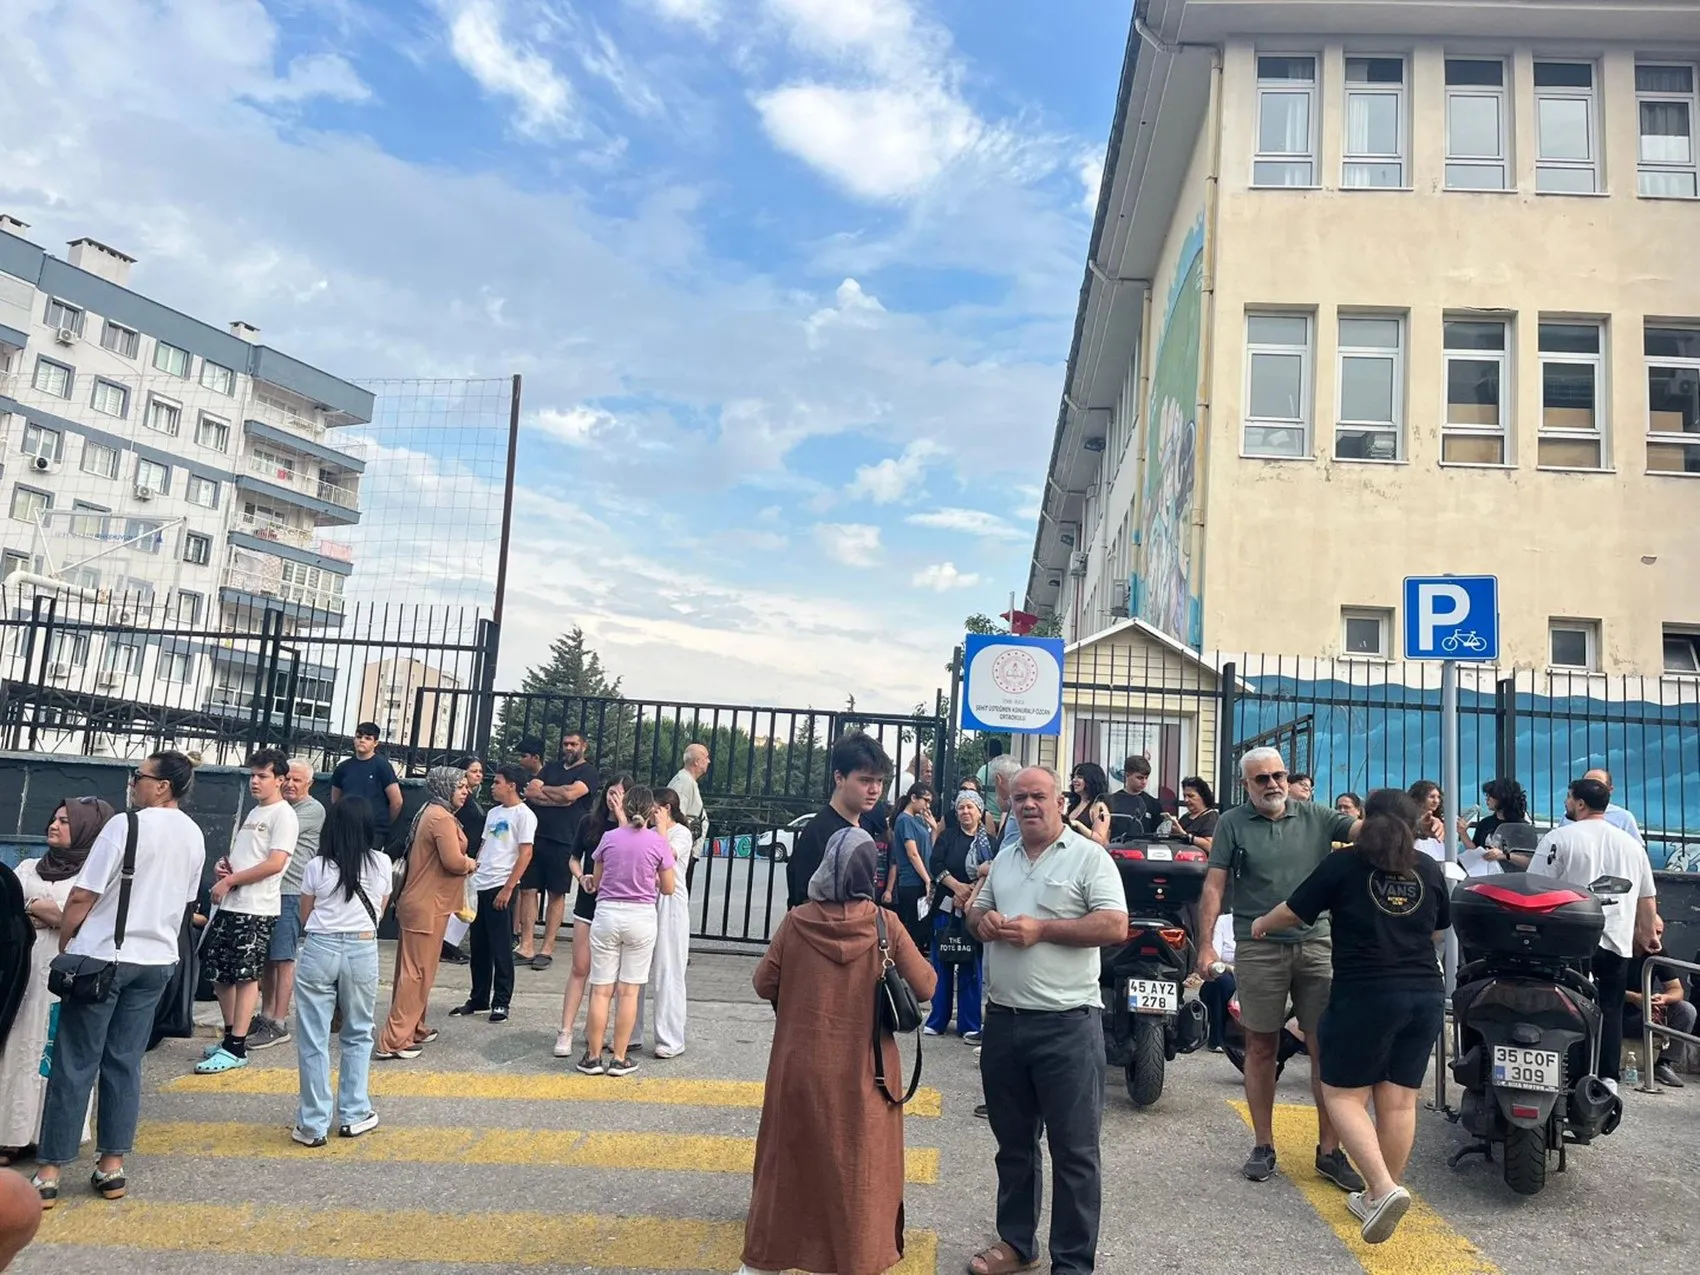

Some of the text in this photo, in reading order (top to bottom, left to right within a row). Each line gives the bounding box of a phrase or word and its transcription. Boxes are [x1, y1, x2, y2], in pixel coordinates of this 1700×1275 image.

[1418, 583, 1470, 651] P
[1375, 880, 1417, 898] VANS
[949, 936, 962, 944] THE
[1130, 981, 1175, 996] 45 AYZ
[1142, 995, 1166, 1008] 278
[1497, 1048, 1556, 1067] 35 COF
[1511, 1066, 1545, 1083] 309
